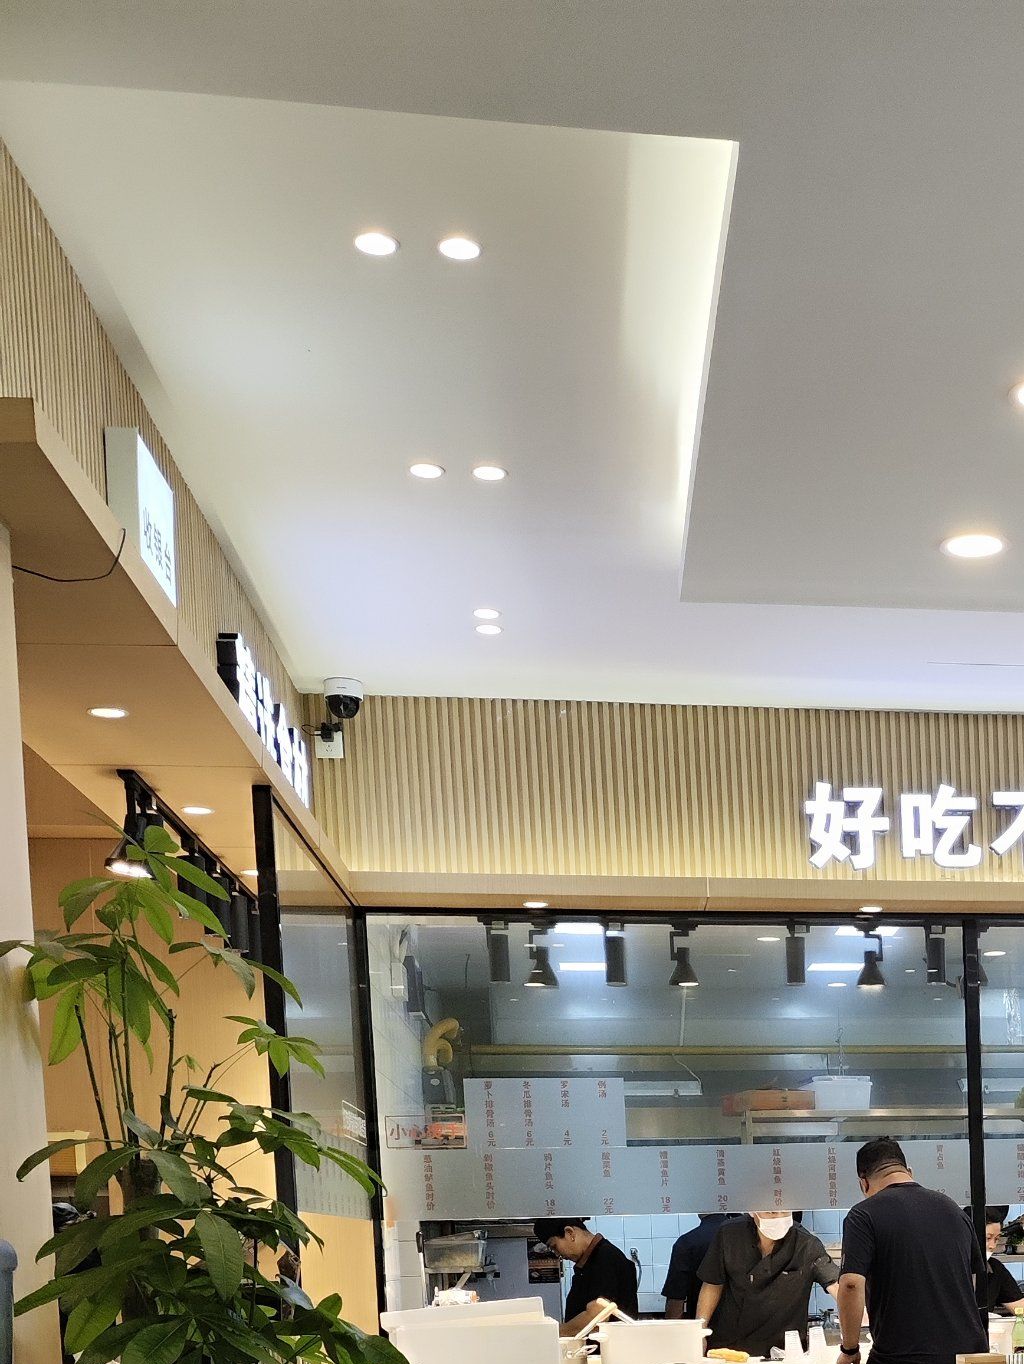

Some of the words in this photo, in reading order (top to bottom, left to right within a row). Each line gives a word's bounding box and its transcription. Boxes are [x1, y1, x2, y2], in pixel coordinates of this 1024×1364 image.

[143, 506, 172, 586] 收银台
[560, 1080, 570, 1108] 罗宋汤
[597, 1080, 607, 1098] 例汤
[484, 1081, 495, 1128] 萝卜排骨汤
[523, 1081, 533, 1127] 冬瓜排骨汤
[389, 1123, 463, 1141] 小心
[487, 1131, 496, 1147] 6元
[526, 1131, 534, 1147] 6元
[563, 1130, 572, 1146] 4元
[601, 1130, 609, 1146] 2元
[602, 1152, 611, 1178] 酸菜鱼
[545, 1199, 556, 1215] 18元
[603, 1198, 614, 1214] 22元
[661, 1196, 671, 1212] 18元
[718, 1195, 728, 1211] 20元
